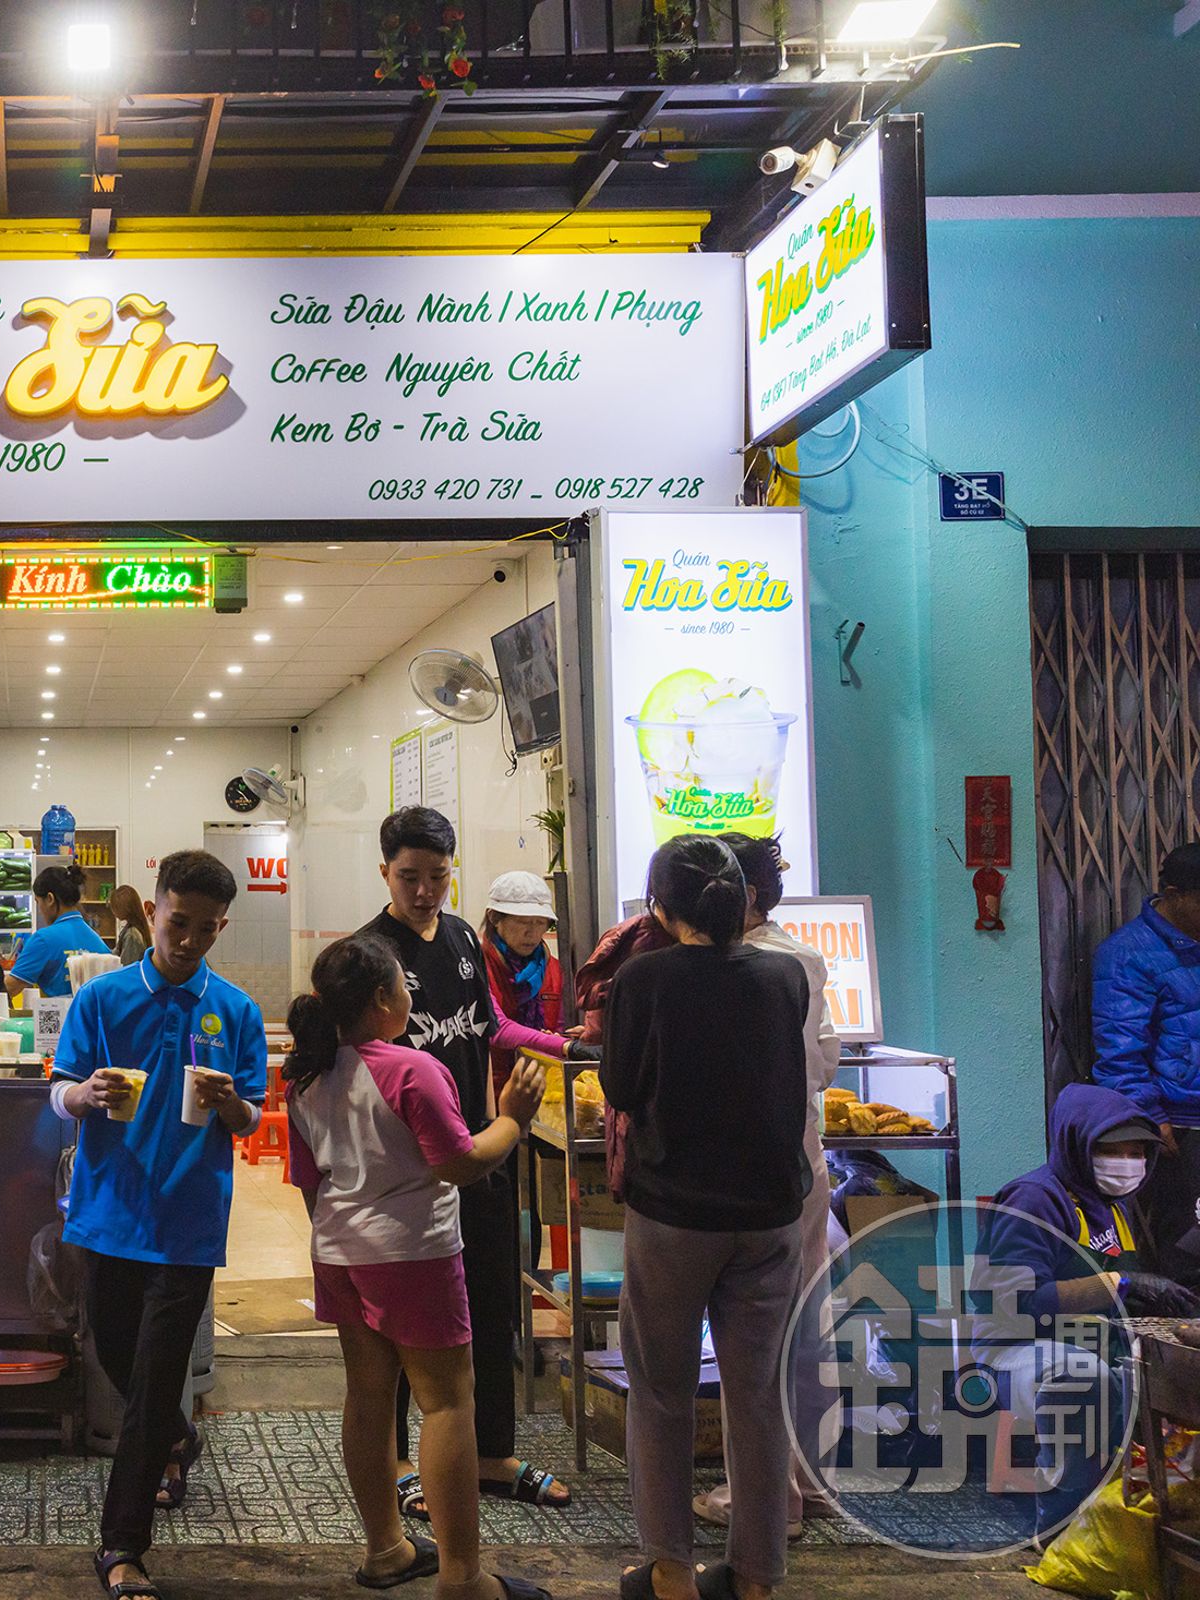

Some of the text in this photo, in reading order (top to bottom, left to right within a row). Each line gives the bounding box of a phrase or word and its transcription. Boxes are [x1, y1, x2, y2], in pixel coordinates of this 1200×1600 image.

[787, 223, 814, 261] Quán
[757, 193, 875, 345] Hoa Sữa
[270, 289, 704, 337] Sữa Đậu Nành Xanh Phụng
[815, 300, 833, 330] 1980
[5, 293, 231, 418] Sữa
[385, 352, 494, 398] Nguyên
[507, 349, 582, 381] Chất
[760, 389, 772, 411] 64
[270, 410, 543, 443] Kem Bơ Trà Sữa
[368, 478, 704, 501] 0933 420 731 0918 527 428
[954, 479, 988, 501] 3E
[672, 549, 711, 568] Quán
[9, 565, 88, 594] Kính
[106, 565, 192, 592] Chào
[621, 559, 793, 612] Hoa Sữa
[680, 621, 735, 635] since 1980
[664, 787, 710, 818] Hoa
